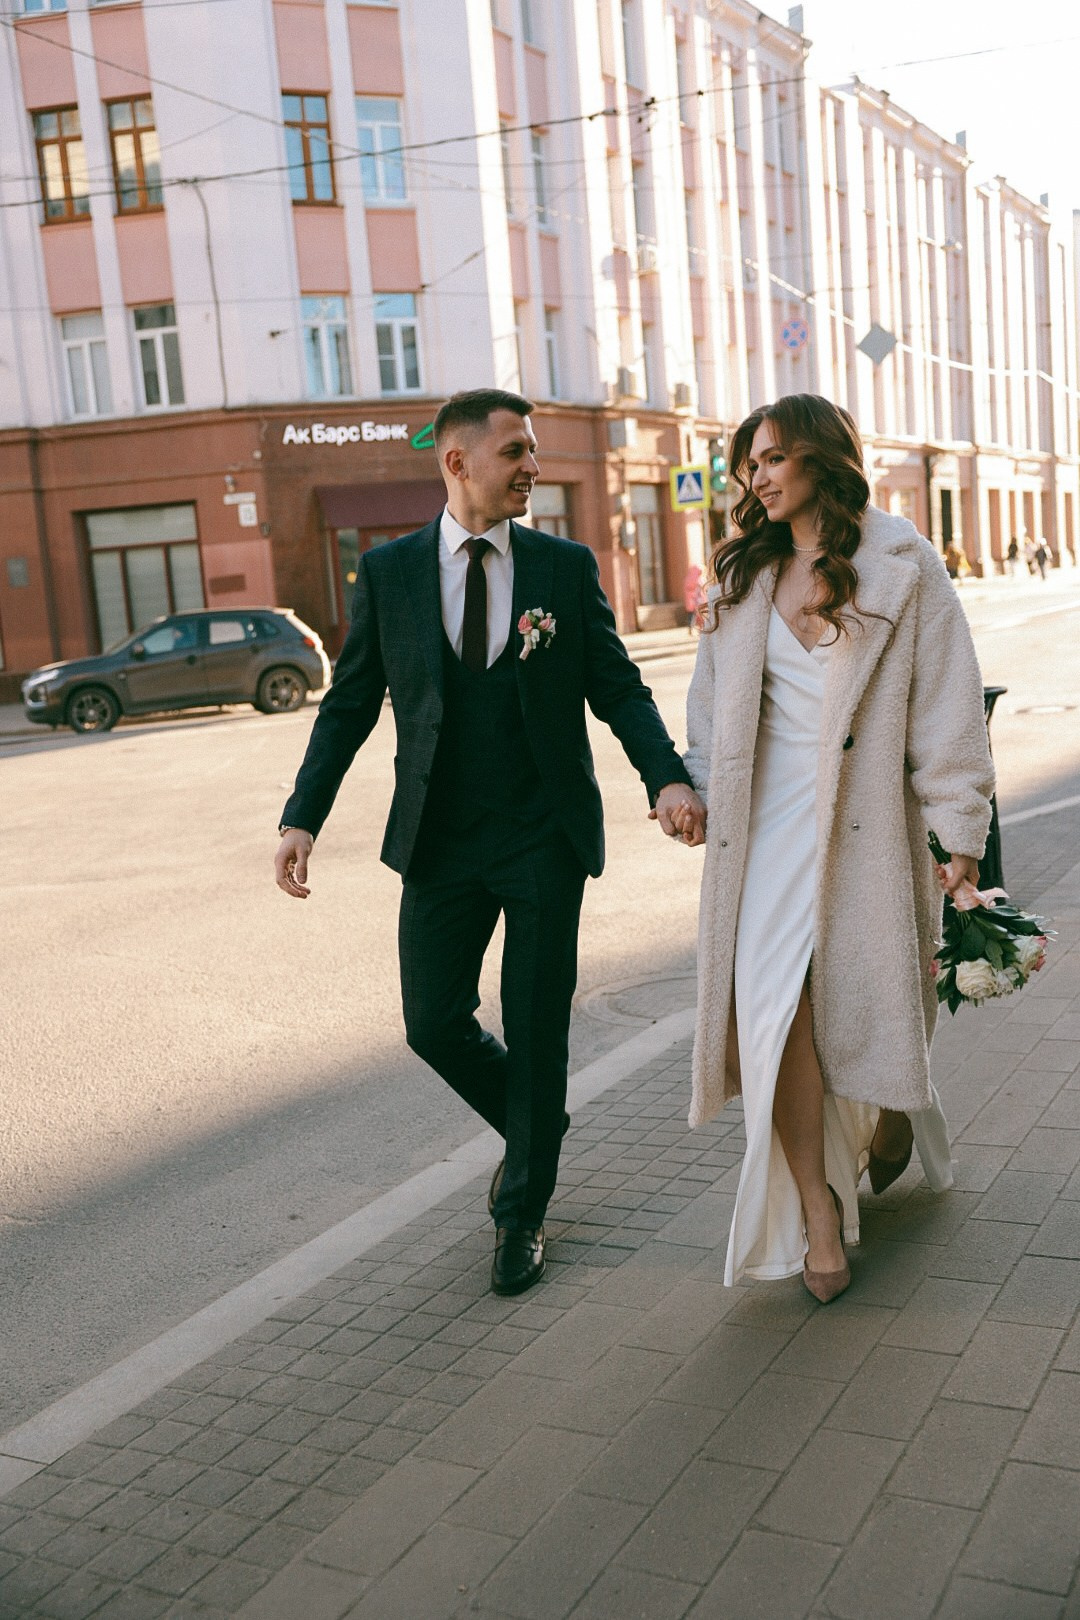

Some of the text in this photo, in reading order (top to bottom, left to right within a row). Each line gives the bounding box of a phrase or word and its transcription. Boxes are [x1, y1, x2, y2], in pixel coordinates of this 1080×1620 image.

[283, 421, 408, 446] Ак Барс Банк
